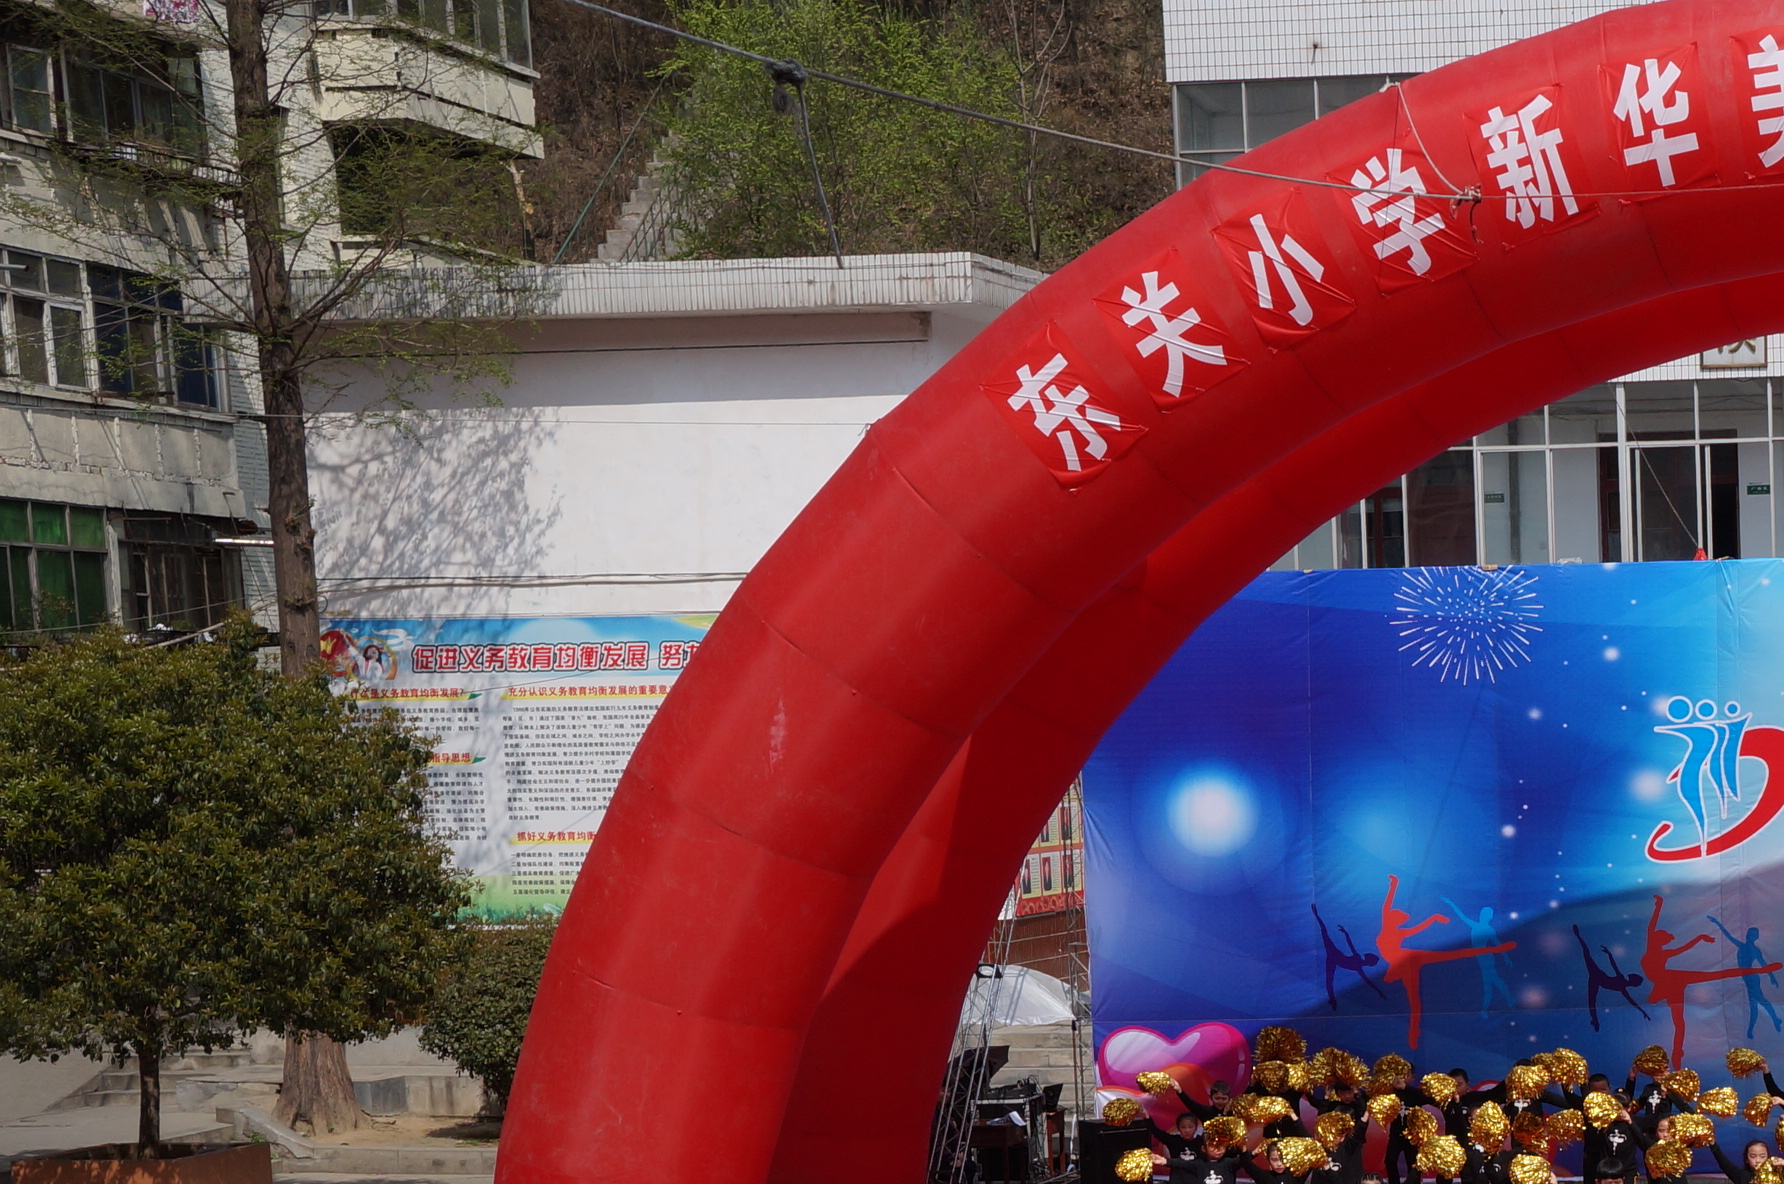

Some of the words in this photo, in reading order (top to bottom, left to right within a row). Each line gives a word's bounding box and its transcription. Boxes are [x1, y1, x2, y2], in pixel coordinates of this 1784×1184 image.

[413, 642, 650, 672] 促进义务教育均衡发展
[427, 752, 472, 763] 指导思想
